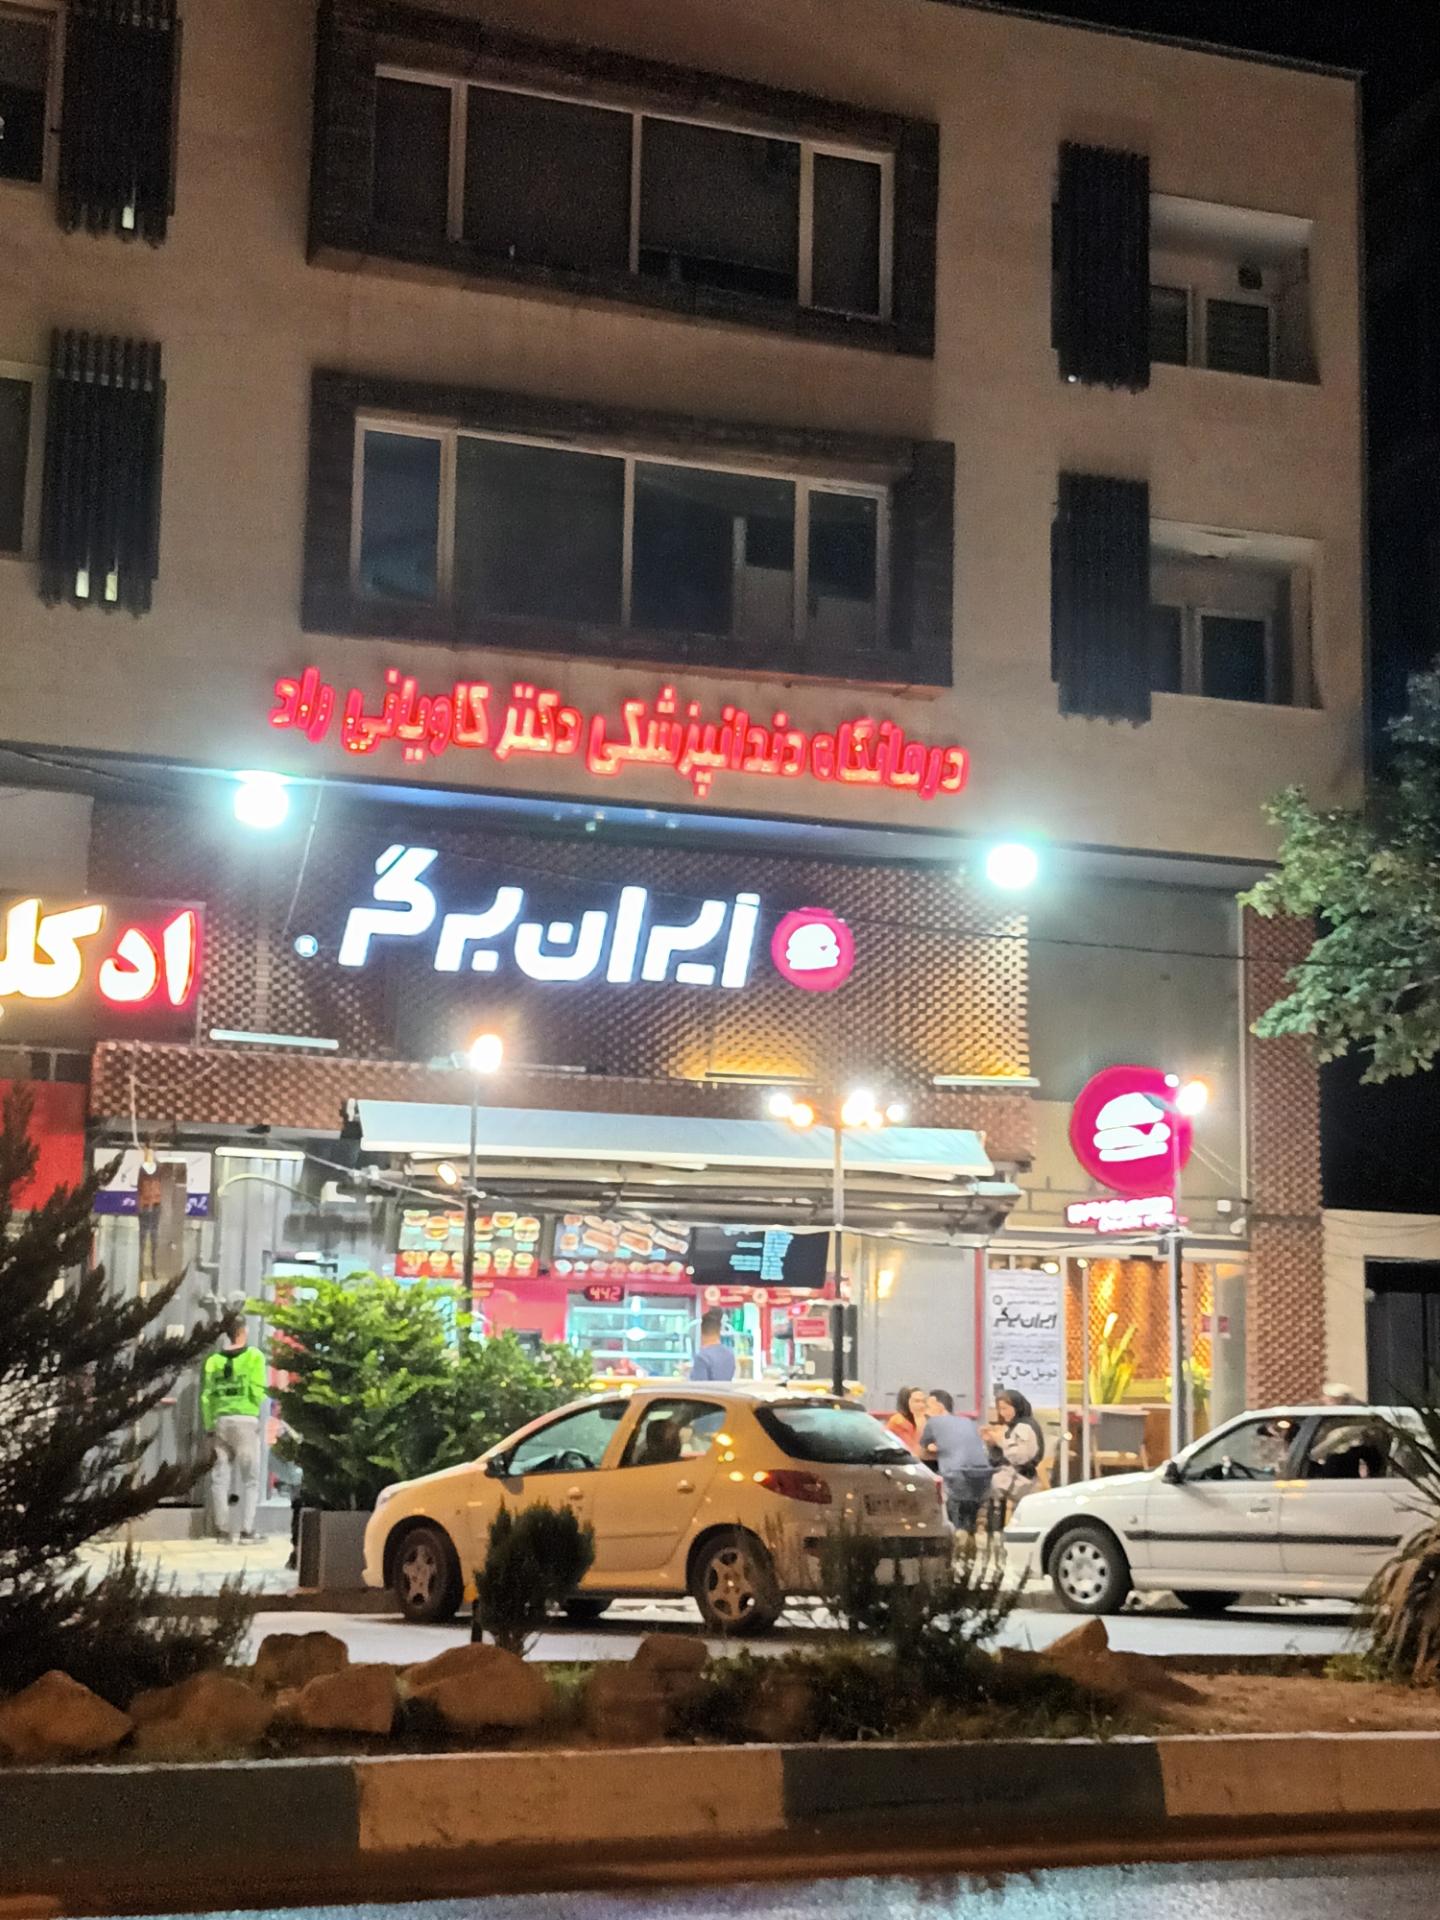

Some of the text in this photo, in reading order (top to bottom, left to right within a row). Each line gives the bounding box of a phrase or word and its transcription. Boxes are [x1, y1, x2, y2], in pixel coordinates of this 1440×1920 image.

[269, 665, 968, 800] درمانگاه دندانپزشکی دکتر کاویانی راد
[338, 844, 761, 989] ایران برگر
